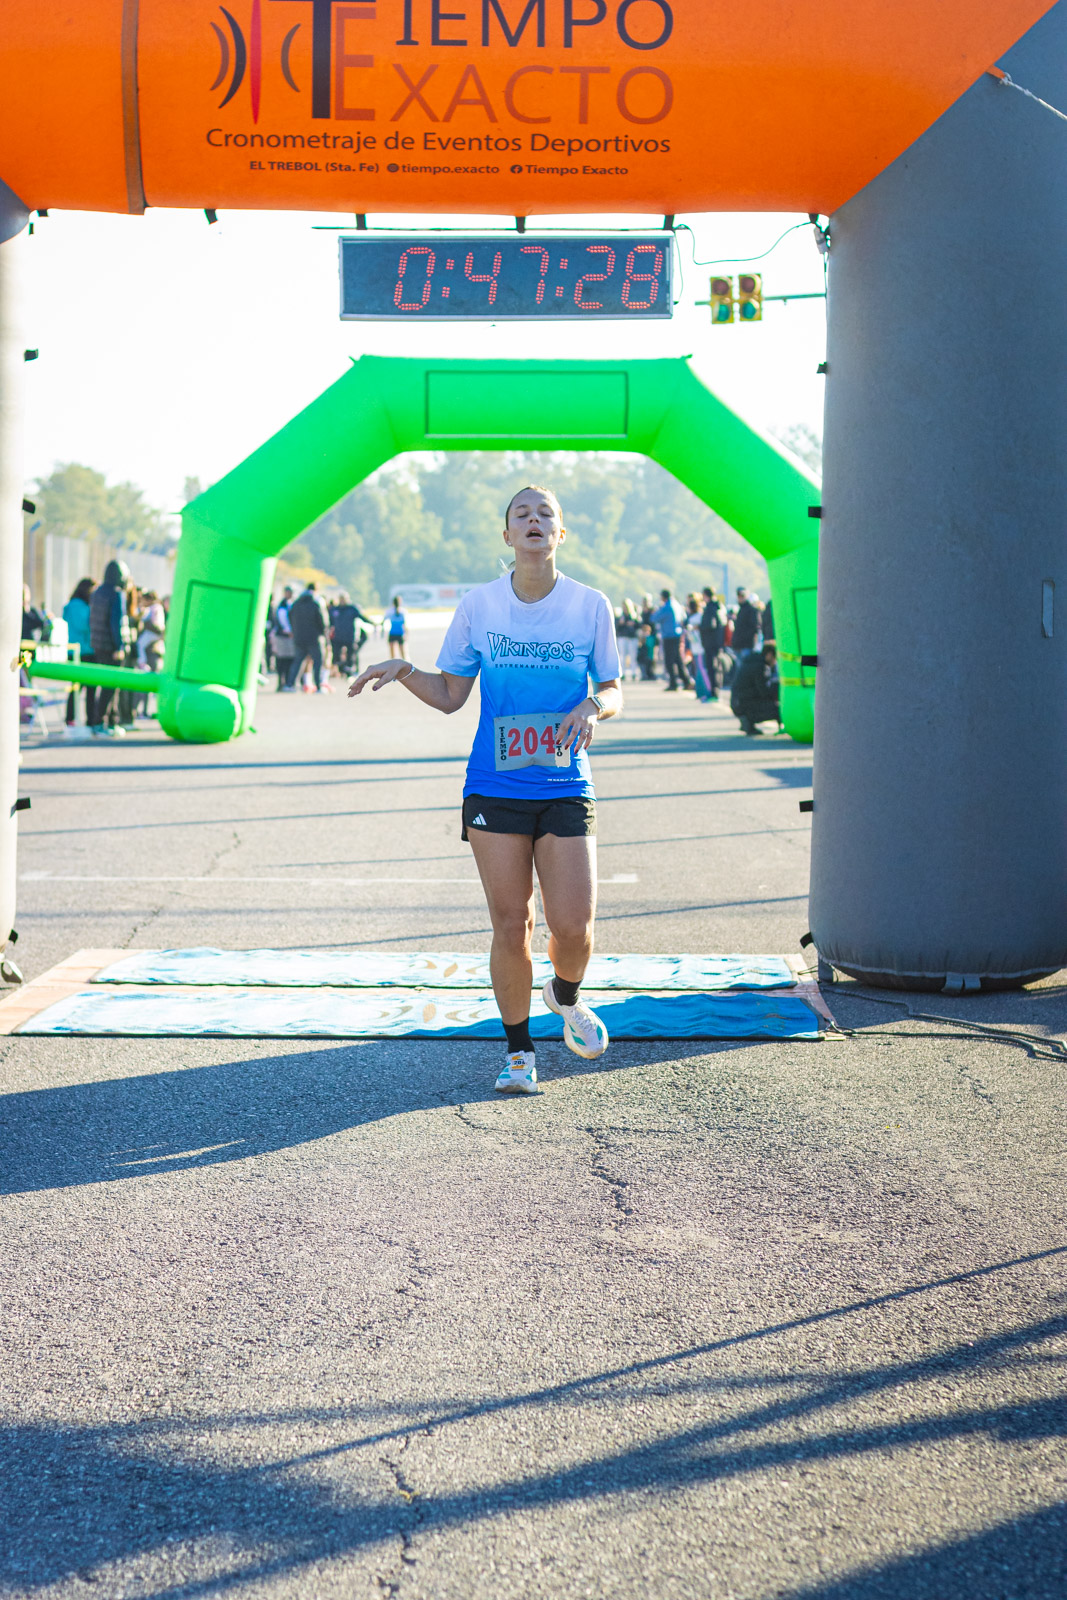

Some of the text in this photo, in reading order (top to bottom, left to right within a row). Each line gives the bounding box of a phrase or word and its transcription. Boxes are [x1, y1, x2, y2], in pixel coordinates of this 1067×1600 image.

[206, 128, 671, 156] Cronometraje de Eventos Deportivos
[250, 161, 265, 170] EL
[268, 161, 322, 172] TREBOL
[325, 162, 356, 172] (Sta.
[359, 162, 379, 173] Fe)
[525, 164, 579, 176] Tiempo
[582, 165, 629, 175] Exacto
[498, 726, 507, 761] TIEMPO
[507, 725, 556, 757] 204
